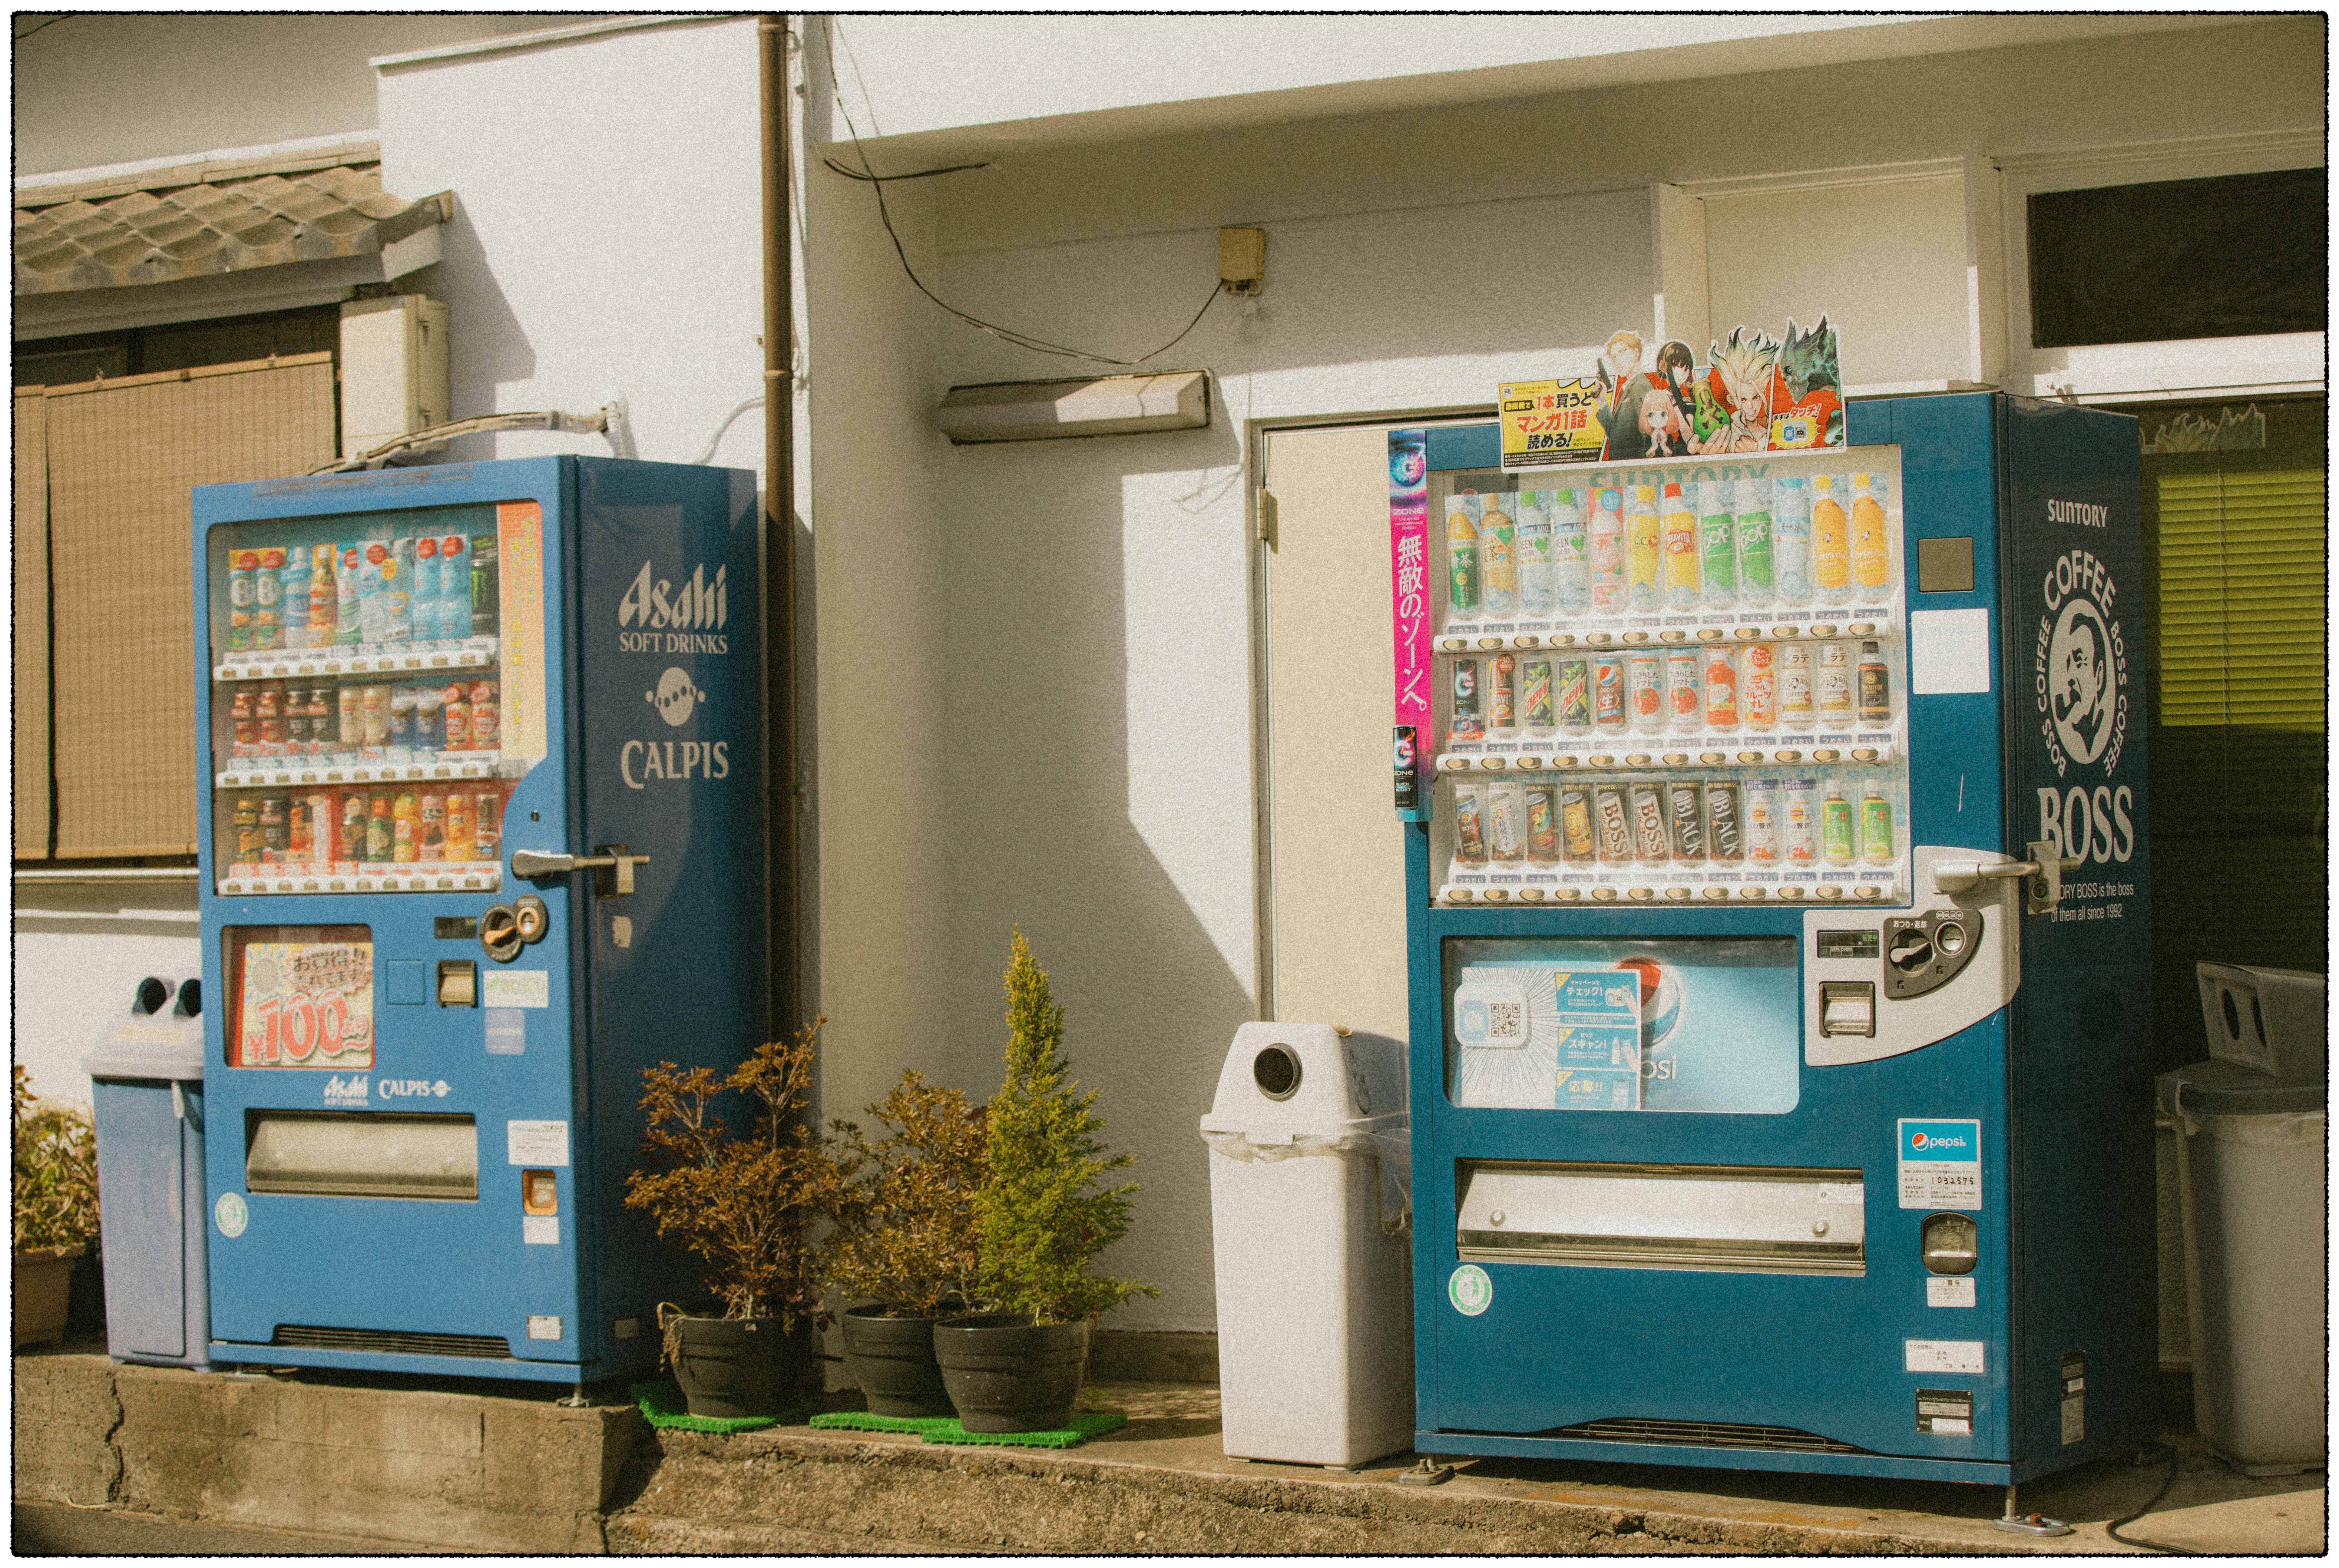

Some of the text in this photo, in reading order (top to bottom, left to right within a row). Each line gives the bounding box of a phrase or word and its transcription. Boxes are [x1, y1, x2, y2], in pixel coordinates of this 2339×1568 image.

[1537, 392, 1592, 410] 1本買うと
[1791, 404, 1822, 418] タッチ!
[1517, 409, 1587, 432] マンガ1話
[1526, 432, 1573, 450] 読める!
[2048, 499, 2108, 527] SUNTORY
[619, 559, 728, 629] Asahi
[2044, 550, 2117, 618] COFFEE
[1398, 534, 1427, 711] 無敵のゾーンへ。
[619, 632, 727, 654] SOFT DRINKS
[1792, 654, 1809, 663] ラテ
[1830, 653, 1847, 662] ラテ
[1745, 691, 1772, 700] フルーツ
[1750, 700, 1765, 709] オレ
[2037, 615, 2066, 778] BOSS COFFEE
[2103, 621, 2127, 778] BOSS COFFEE
[621, 740, 729, 789] CALPIS
[1604, 800, 1628, 853] BOSS
[1641, 800, 1665, 853] BOSS
[1676, 797, 1703, 855] BLACK
[1712, 797, 1740, 855] BLACK
[2037, 785, 2133, 863] BOSS
[2077, 883, 2097, 899] BOSS
[2099, 882, 2105, 897] is
[2106, 882, 2117, 896] the
[2118, 881, 2134, 896] boss
[2060, 906, 2077, 922] them
[2078, 906, 2086, 920] all
[2087, 904, 2105, 919] since
[2106, 903, 2123, 917] 1992
[1893, 920, 1927, 929] おつり・返却
[1566, 986, 1603, 996] チェック!
[1569, 1039, 1607, 1049] スキャン!
[324, 1075, 368, 1098] Asahi
[378, 1079, 431, 1099] CALPIS
[1930, 1136, 1963, 1149] pepsi
[1931, 1177, 1974, 1185] 1032575
